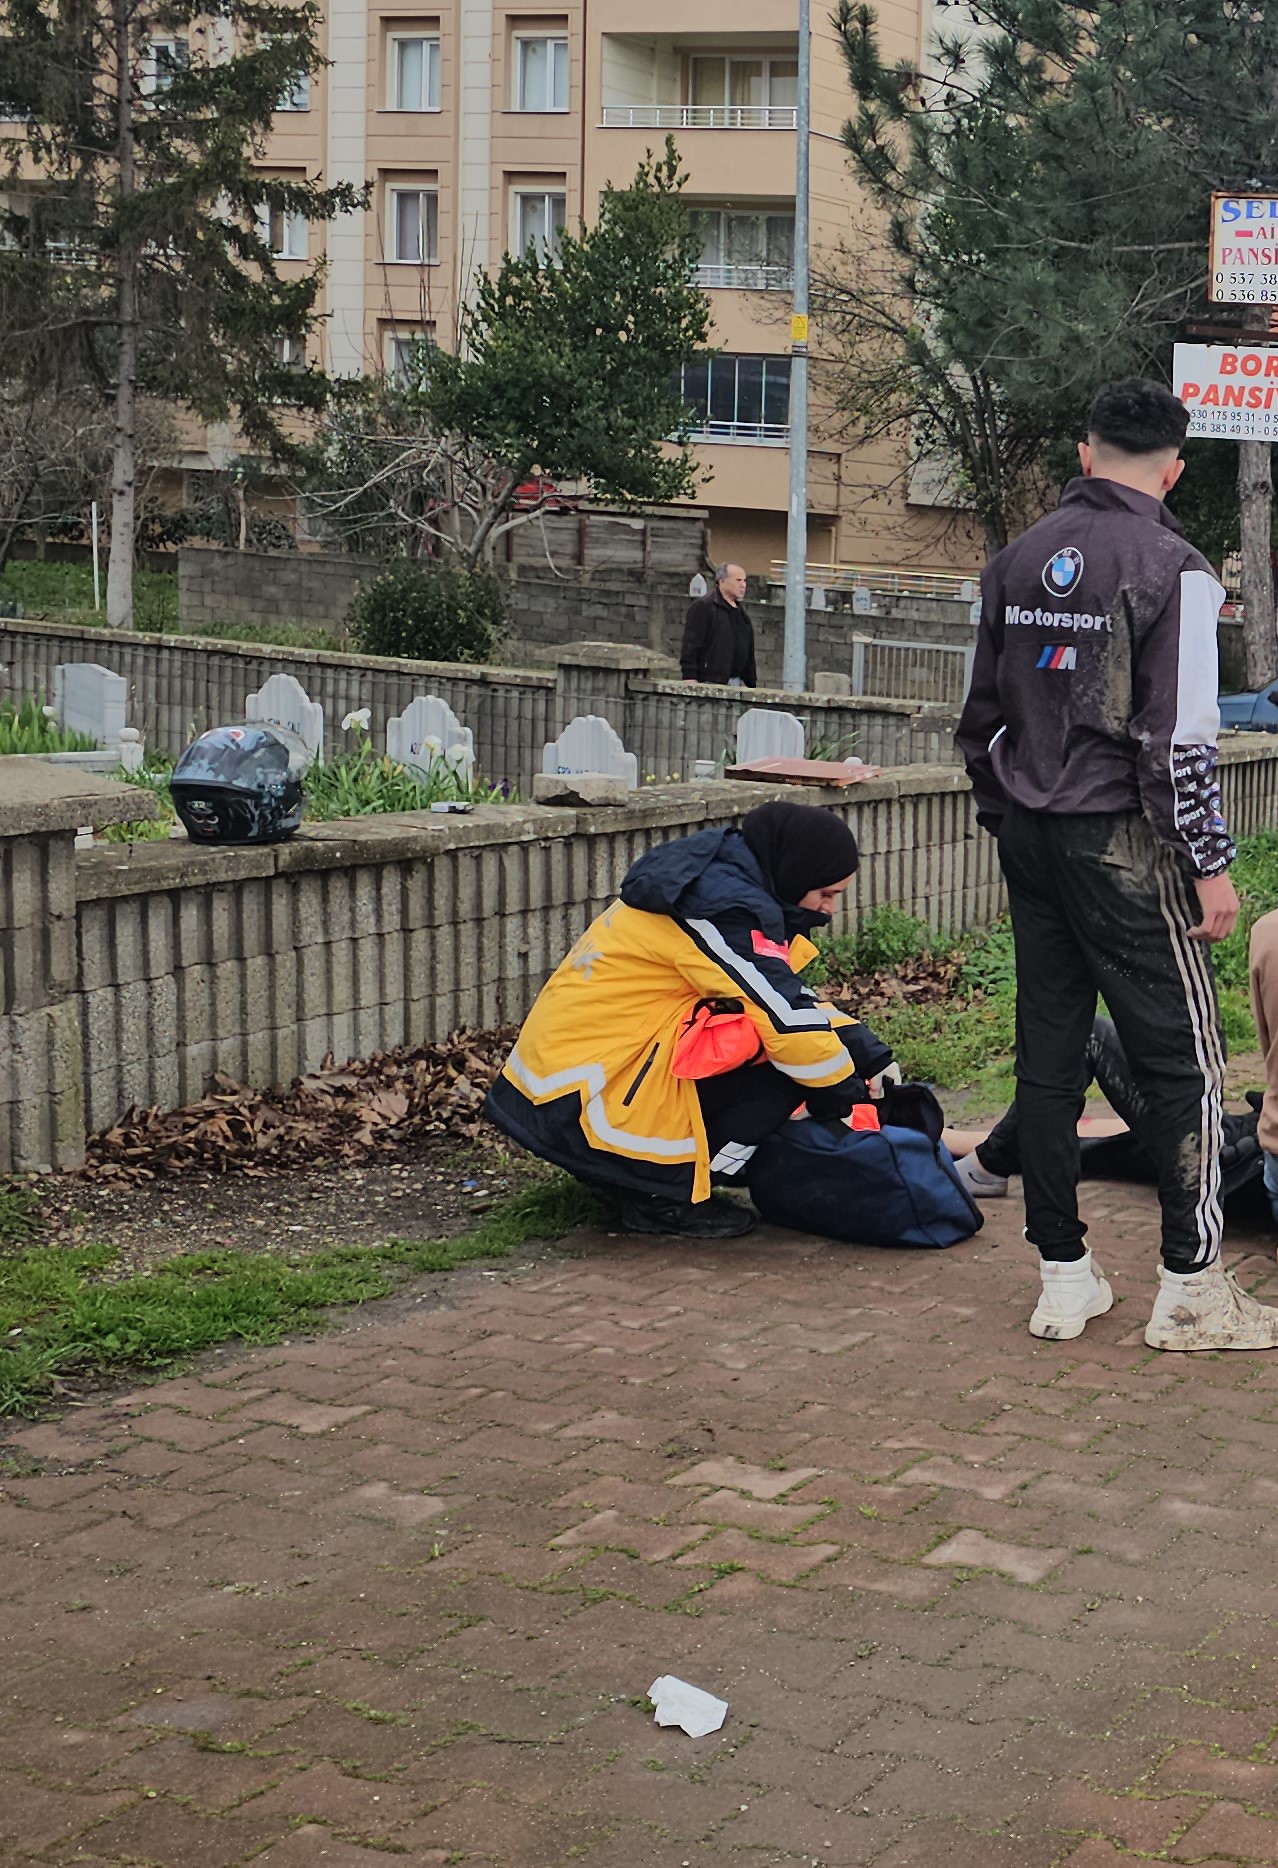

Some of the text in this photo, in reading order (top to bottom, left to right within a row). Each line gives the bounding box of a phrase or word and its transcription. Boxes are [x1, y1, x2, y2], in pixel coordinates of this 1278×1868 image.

[1216, 272, 1224, 283] 0
[1229, 273, 1255, 284] 537
[1216, 289, 1224, 301] 0
[1229, 289, 1255, 301] 536
[1191, 409, 1207, 419] 530
[1211, 410, 1228, 420] 175
[1230, 411, 1242, 421] 95
[1245, 412, 1255, 422] 31
[1264, 413, 1270, 423] 0
[1190, 422, 1207, 432] 536
[1210, 423, 1227, 433] 383
[1230, 424, 1241, 434] 49
[1244, 425, 1254, 435] 31
[1264, 426, 1269, 435] 0
[1005, 605, 1112, 632] Motorsport
[1178, 806, 1206, 826] sport
